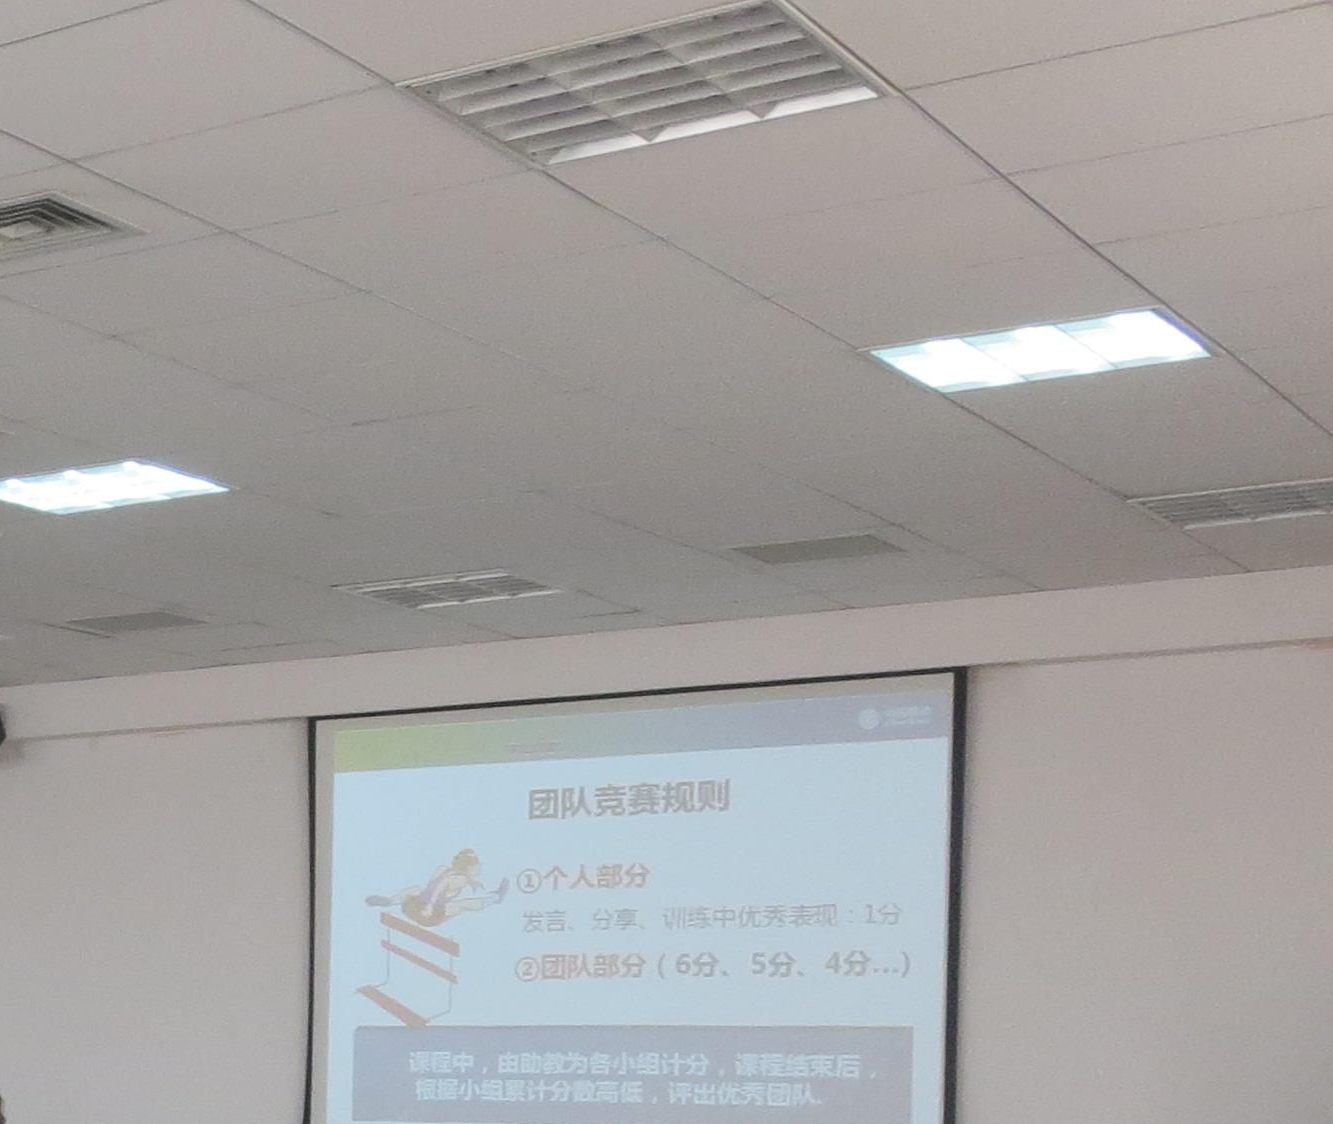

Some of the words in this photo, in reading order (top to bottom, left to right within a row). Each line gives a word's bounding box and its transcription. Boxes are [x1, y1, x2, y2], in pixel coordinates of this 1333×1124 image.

[528, 778, 731, 820] 团队竞赛规则
[516, 863, 650, 894] ①个人部分
